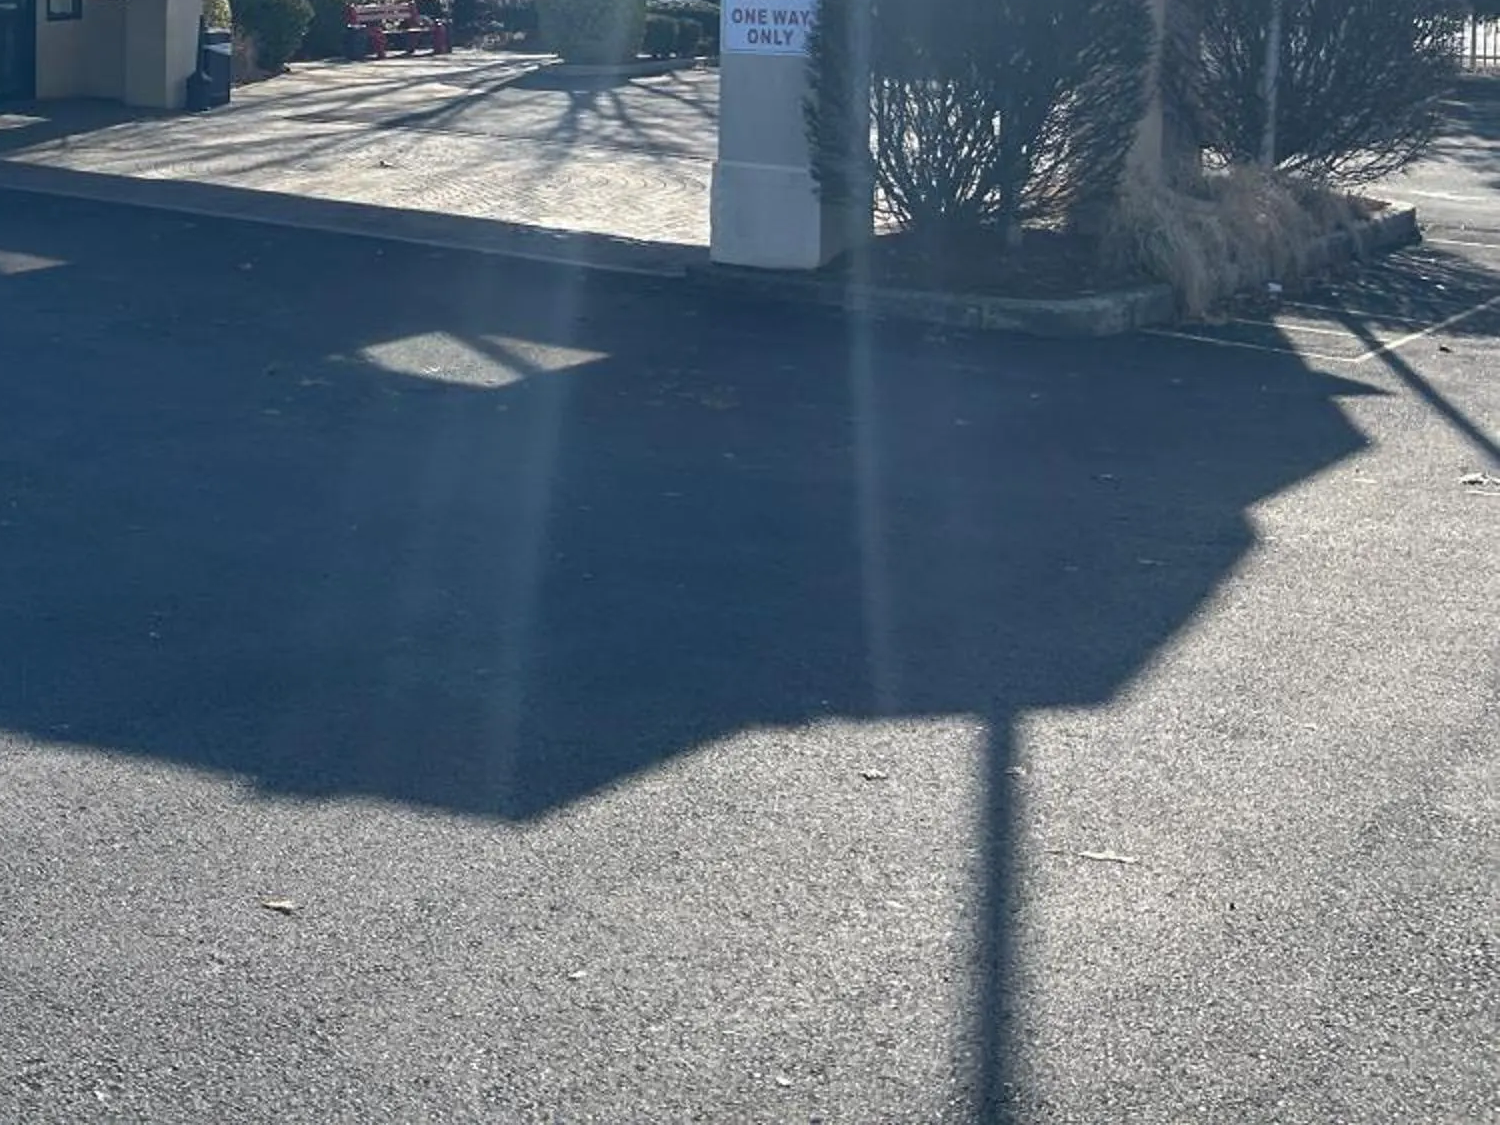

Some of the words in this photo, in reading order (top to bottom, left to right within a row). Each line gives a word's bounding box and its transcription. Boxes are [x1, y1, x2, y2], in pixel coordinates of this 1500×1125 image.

[731, 8, 768, 25] ONE
[773, 10, 810, 27] WAY
[747, 28, 793, 46] ONLY
